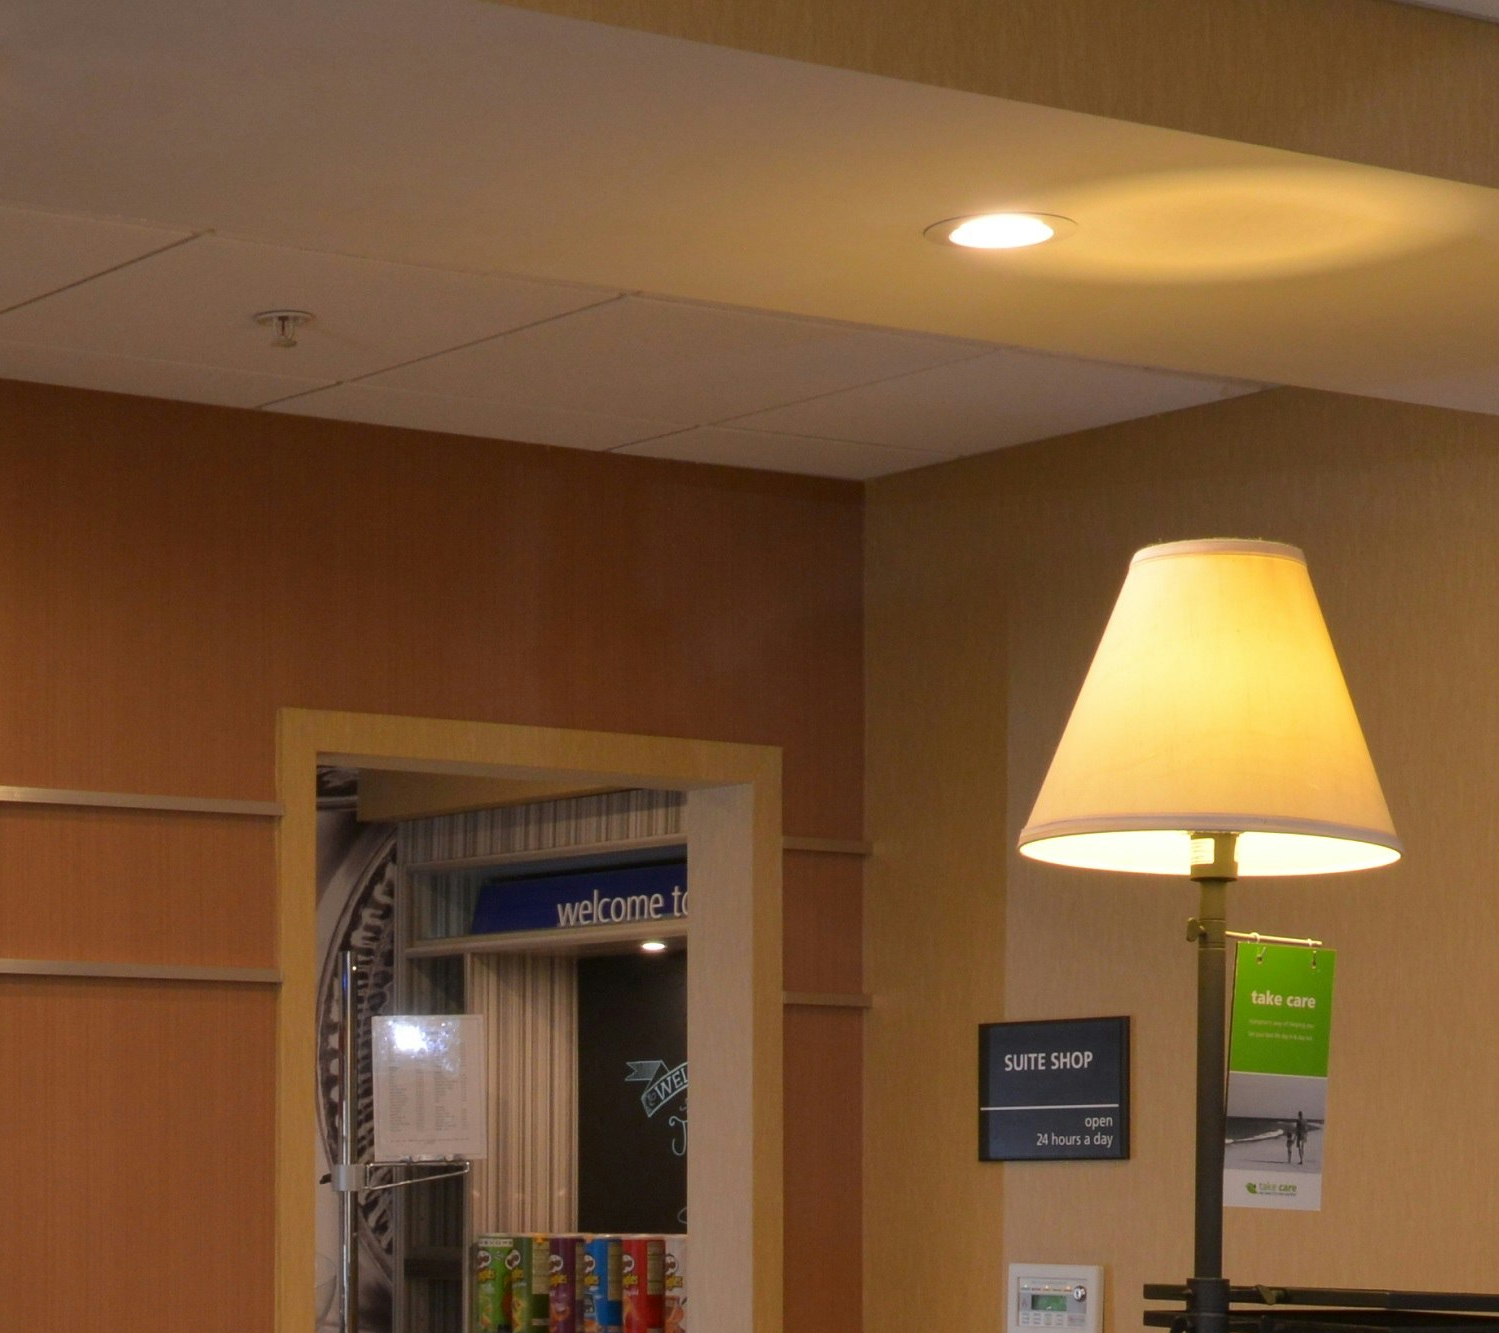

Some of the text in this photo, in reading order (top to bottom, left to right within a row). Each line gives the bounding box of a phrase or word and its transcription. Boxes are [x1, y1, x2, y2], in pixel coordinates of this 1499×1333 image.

[557, 889, 664, 926] welcome
[1251, 990, 1316, 1009] take care
[1004, 1051, 1094, 1071] SUITE SHOP
[1084, 1116, 1113, 1131] open
[1036, 1131, 1114, 1148] 24 hours a day
